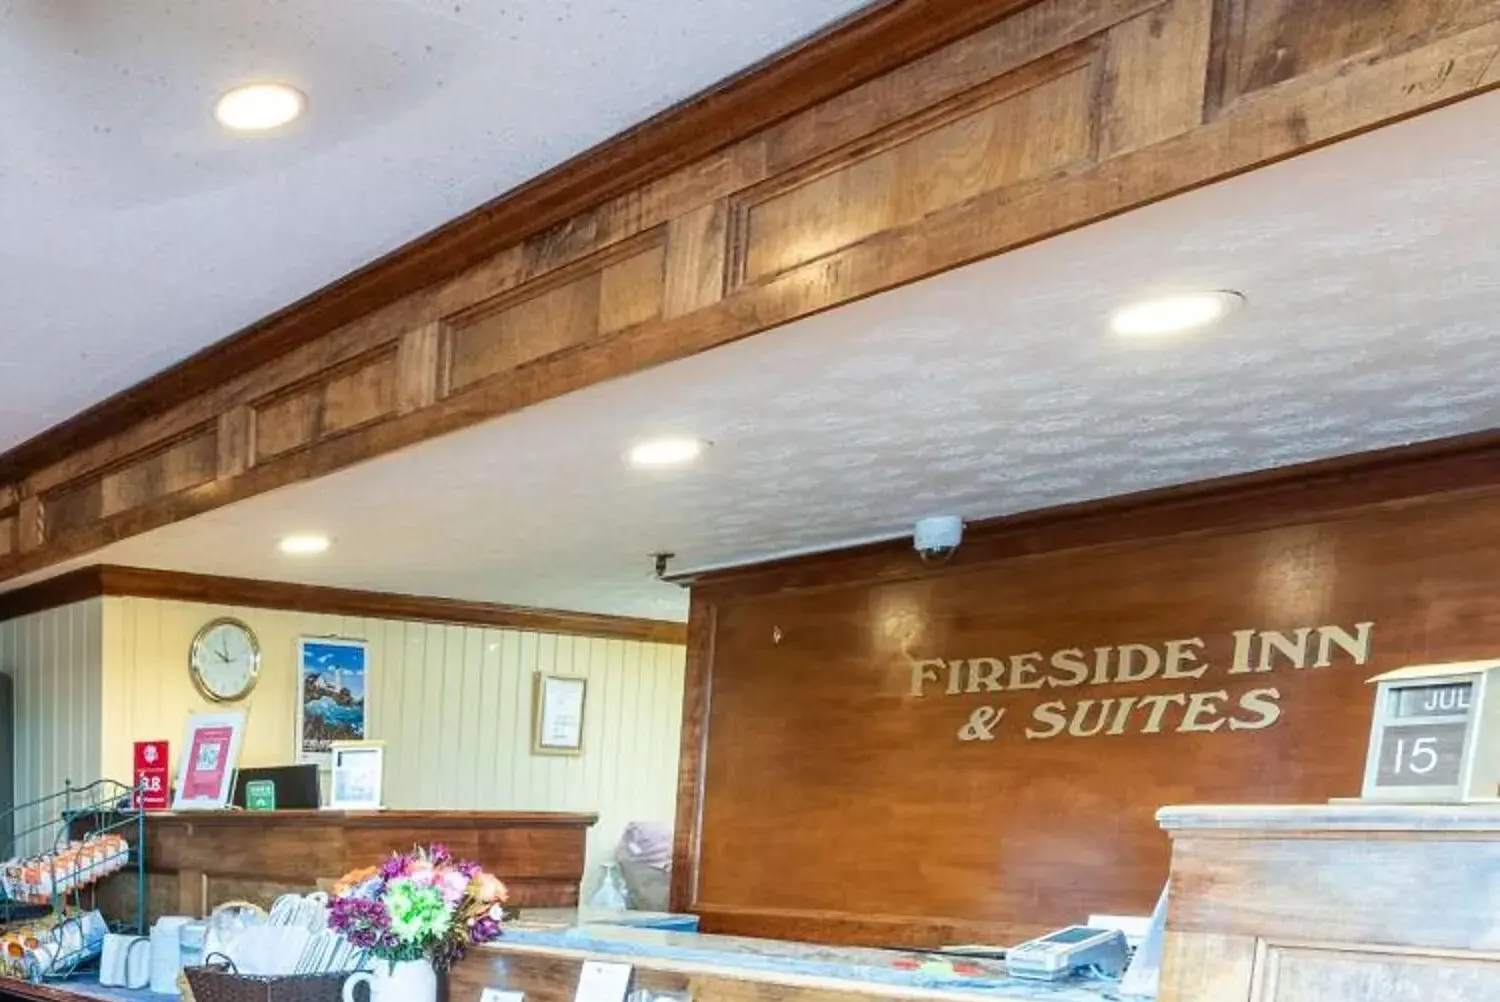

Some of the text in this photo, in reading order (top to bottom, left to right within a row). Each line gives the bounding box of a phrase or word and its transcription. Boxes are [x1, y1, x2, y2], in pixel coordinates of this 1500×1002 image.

[909, 622, 1375, 697] FIRESIDE INN
[957, 687, 1281, 741] & SUITES
[1424, 688, 1472, 711] JUL
[1394, 736, 1439, 776] 15
